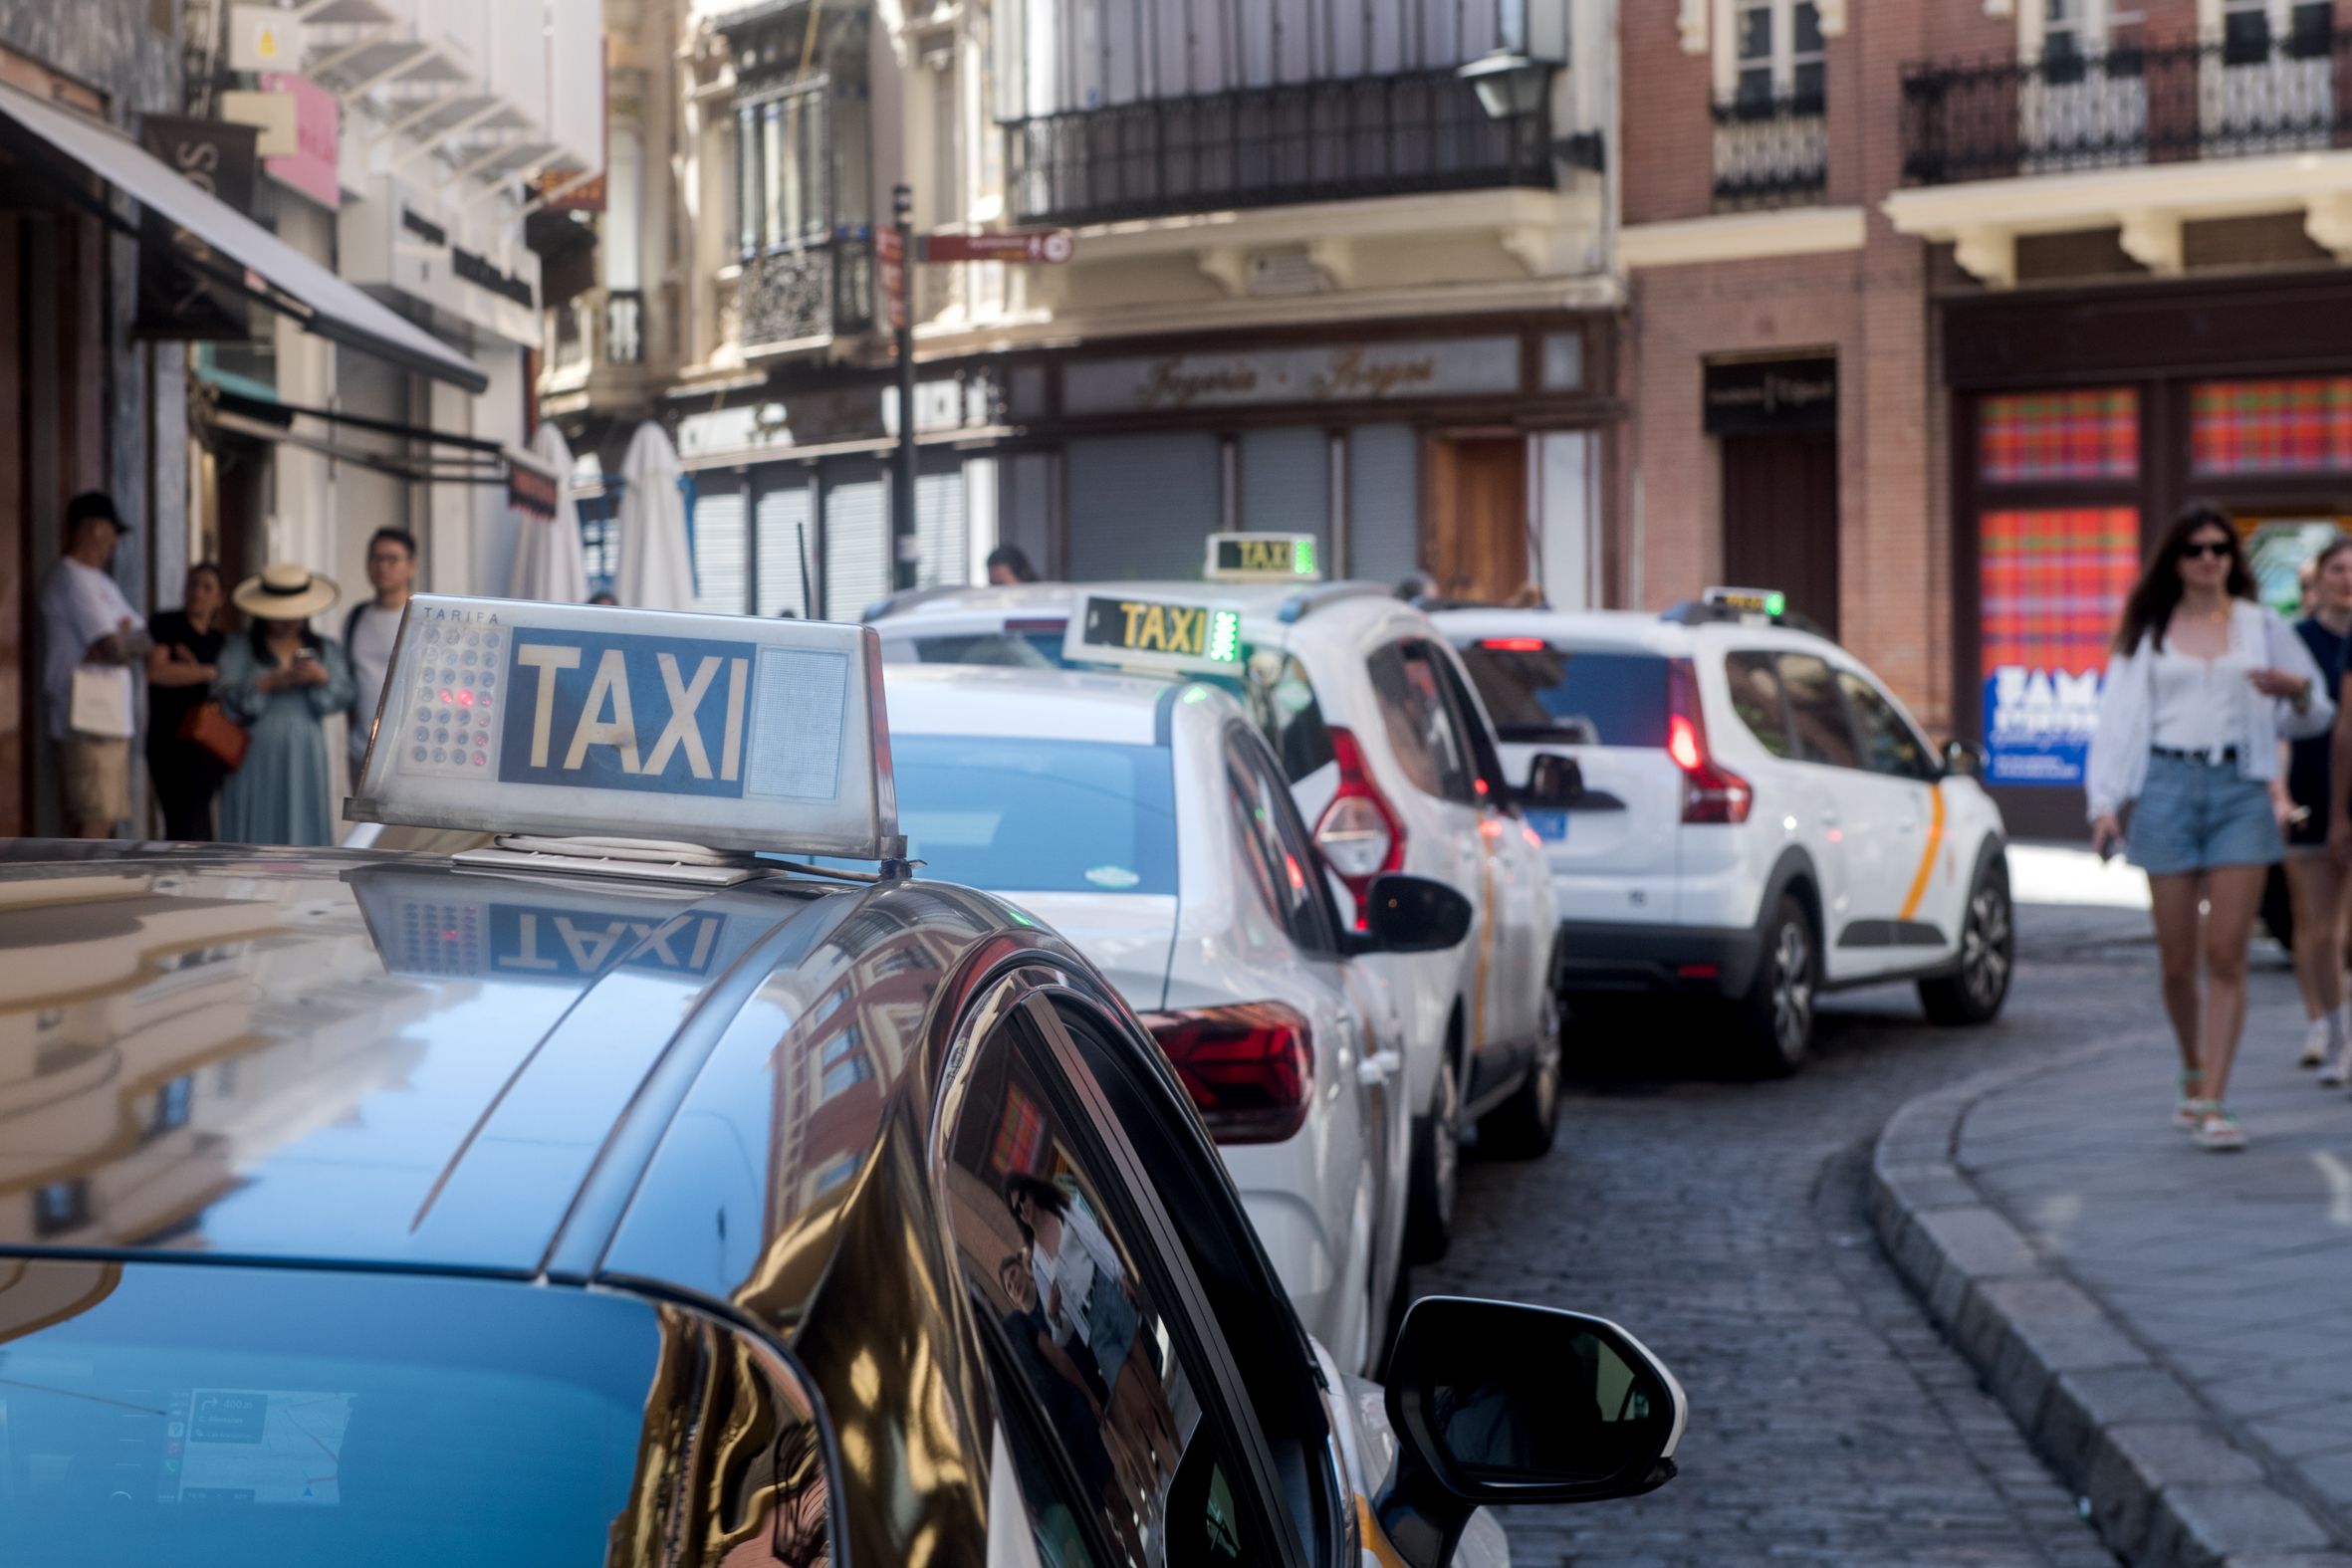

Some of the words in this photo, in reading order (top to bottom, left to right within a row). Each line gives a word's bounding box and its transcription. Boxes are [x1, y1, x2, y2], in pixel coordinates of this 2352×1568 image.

[1236, 541, 1292, 570] TAXI
[424, 607, 499, 624] TARIFA
[1120, 601, 1207, 655] TAXI
[517, 644, 749, 782] TAXI
